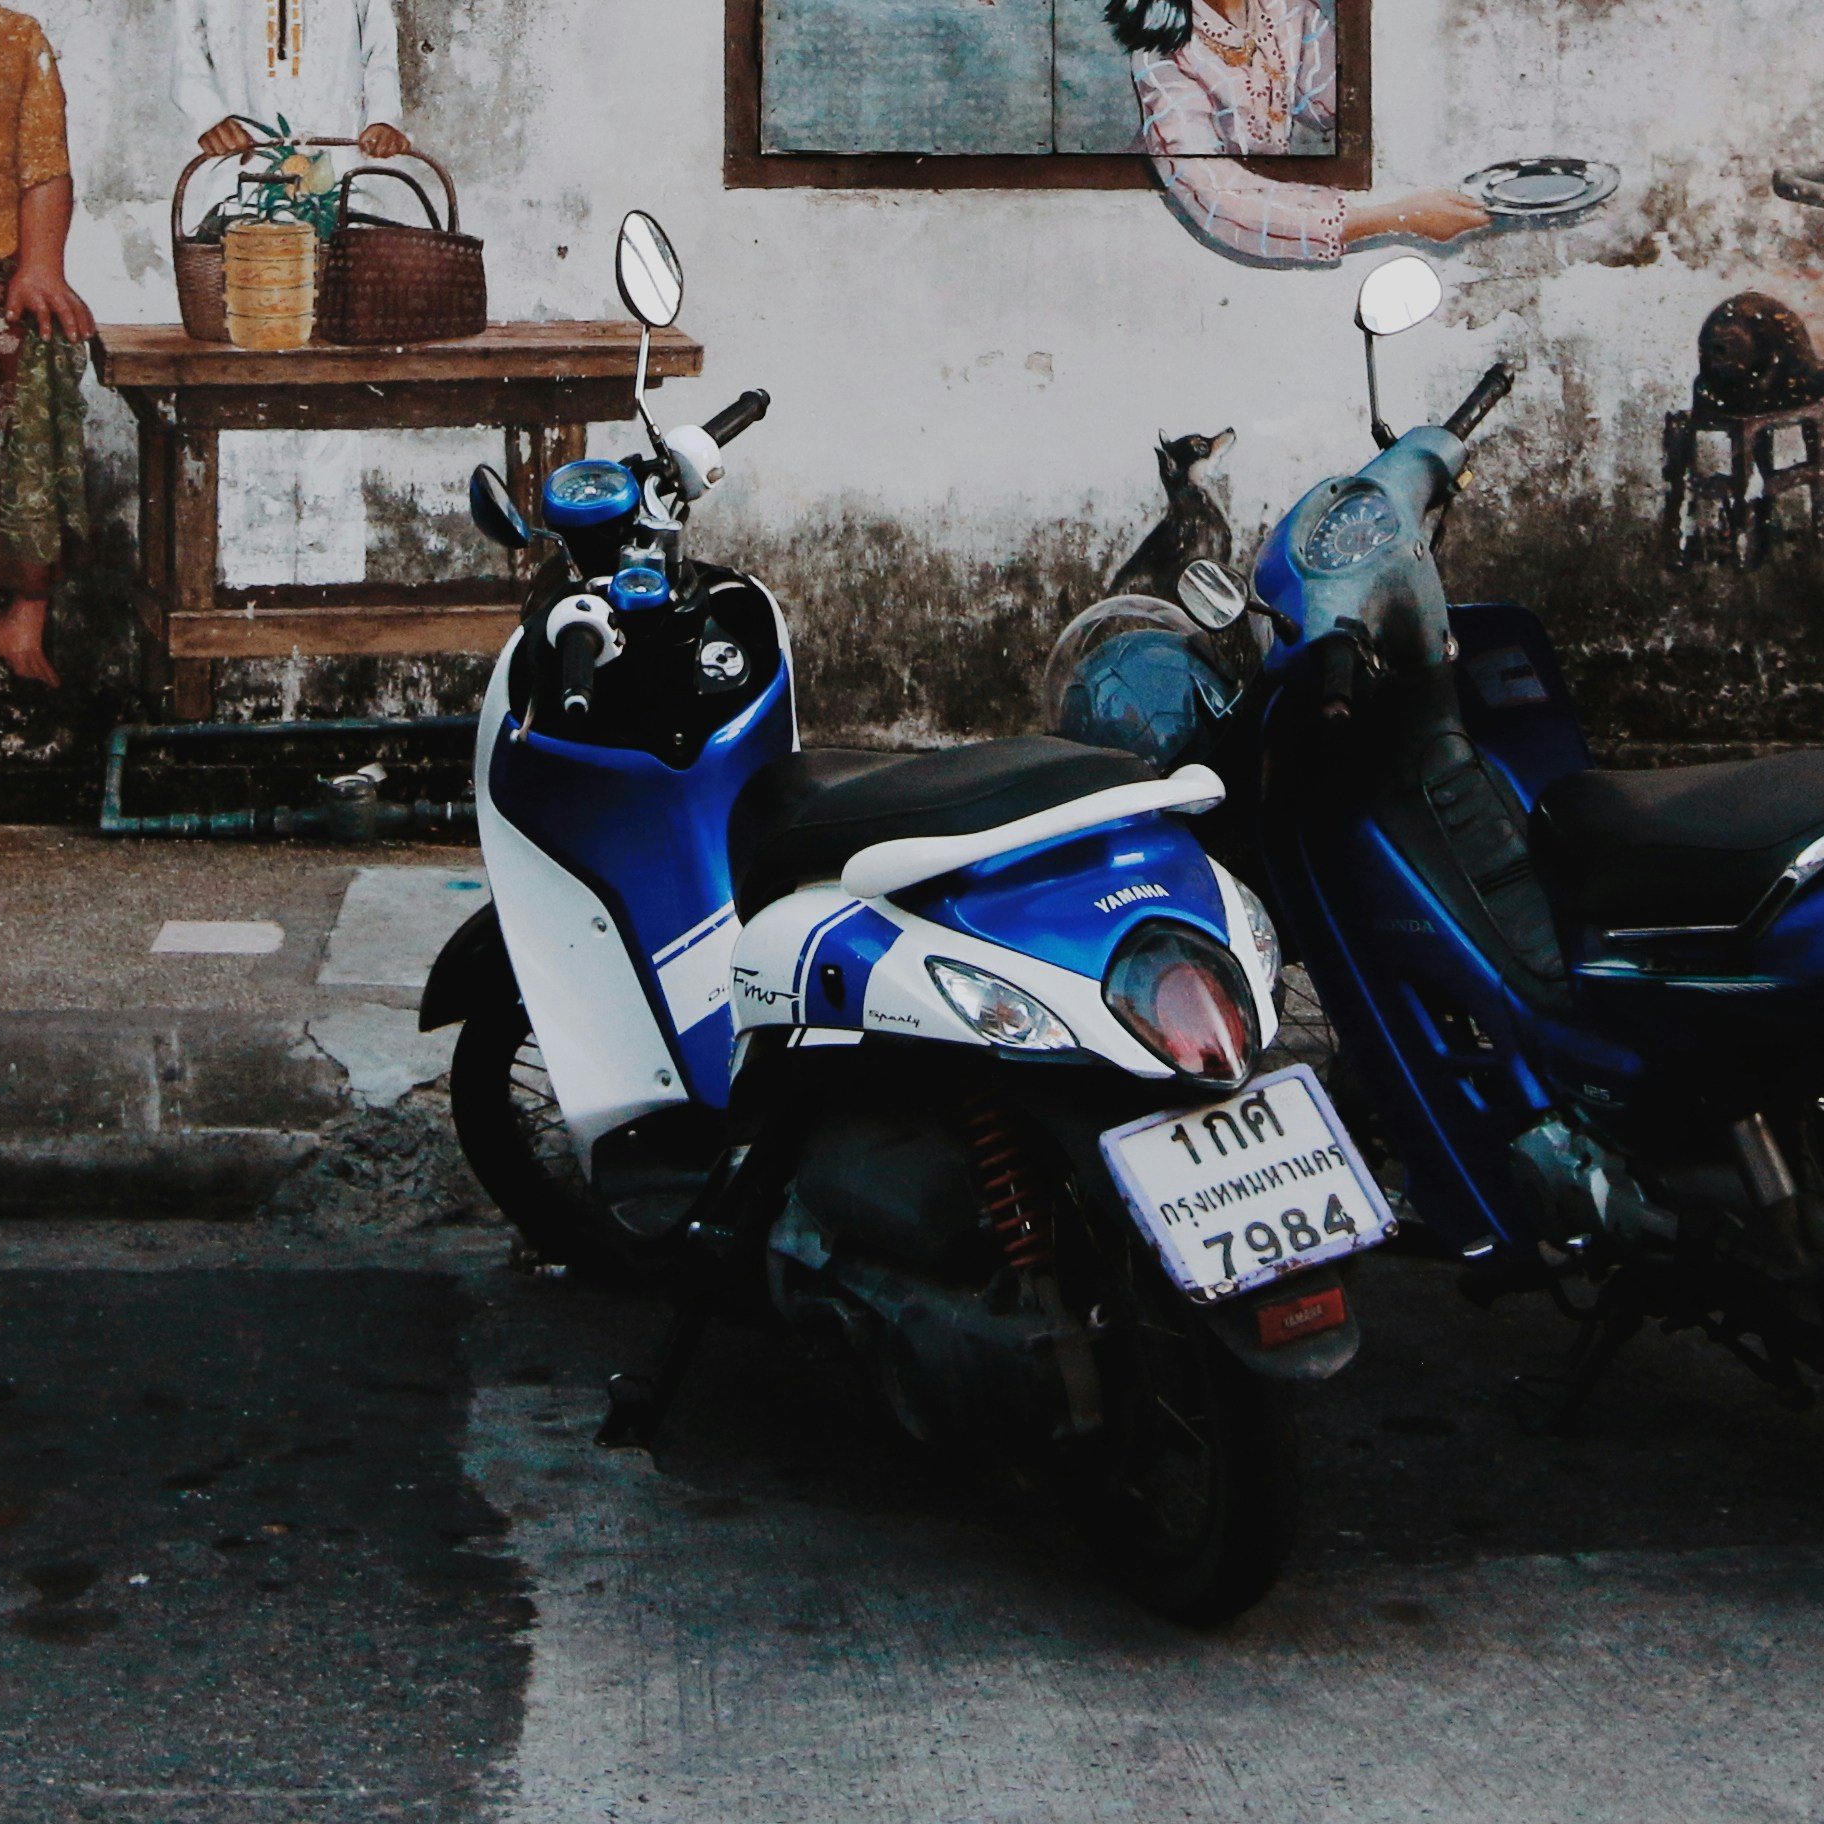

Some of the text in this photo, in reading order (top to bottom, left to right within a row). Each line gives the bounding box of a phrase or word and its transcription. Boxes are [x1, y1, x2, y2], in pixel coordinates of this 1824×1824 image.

[1093, 883, 1171, 914] YAMAHA
[1170, 1088, 1285, 1166] 1กศ
[1158, 1143, 1347, 1228] กรุงเทพมหานคร
[1202, 1192, 1358, 1280] 7984
